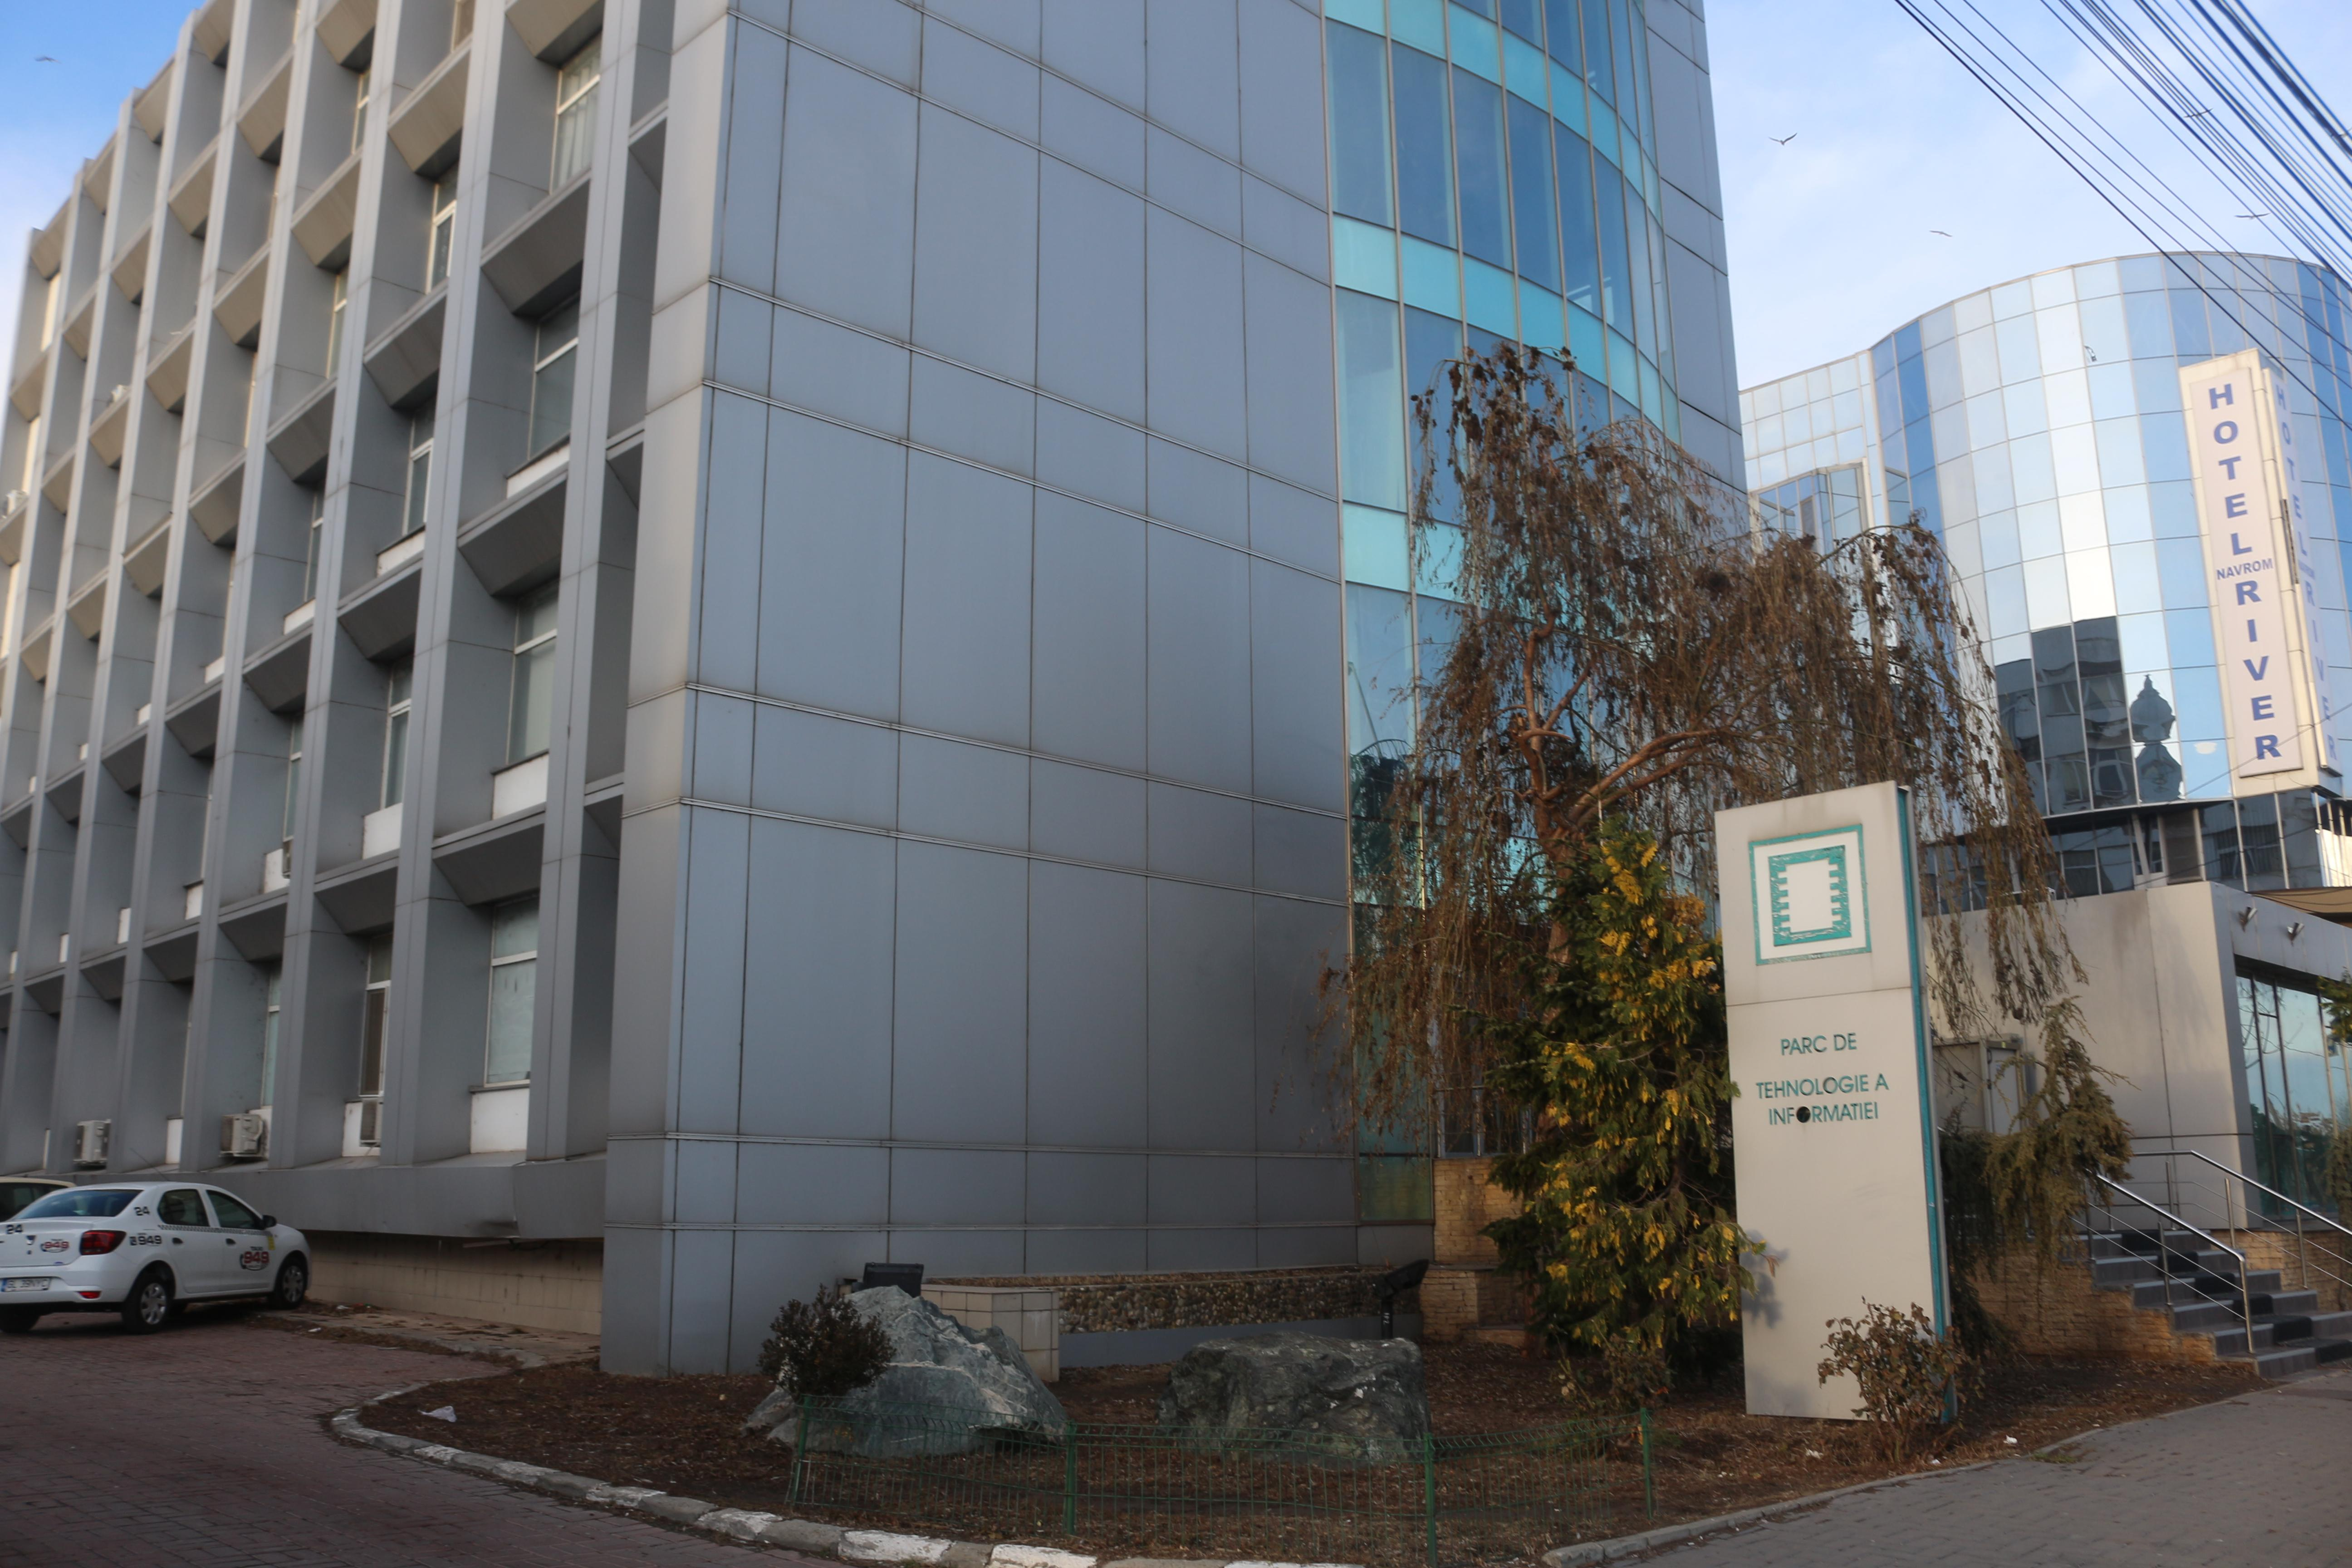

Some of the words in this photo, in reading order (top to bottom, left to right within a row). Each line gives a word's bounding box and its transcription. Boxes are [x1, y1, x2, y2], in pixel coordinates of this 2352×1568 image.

[2208, 383, 2253, 556] HOTEL
[2276, 384, 2307, 557] HOTEL
[2216, 558, 2274, 580] NAVROM
[2235, 580, 2283, 760] RIVER
[2305, 580, 2338, 761] RIVER
[1780, 1035, 1827, 1056] PARC
[1833, 1032, 1857, 1051] DE
[1755, 1074, 1869, 1099] TEHNOLOGIE
[1874, 1073, 1890, 1091] A
[1768, 1101, 1879, 1126] INFORMATIEI
[134, 1206, 150, 1216] 24
[6, 1224, 23, 1235] 24
[138, 1235, 162, 1245] 949
[244, 1251, 270, 1264] 949
